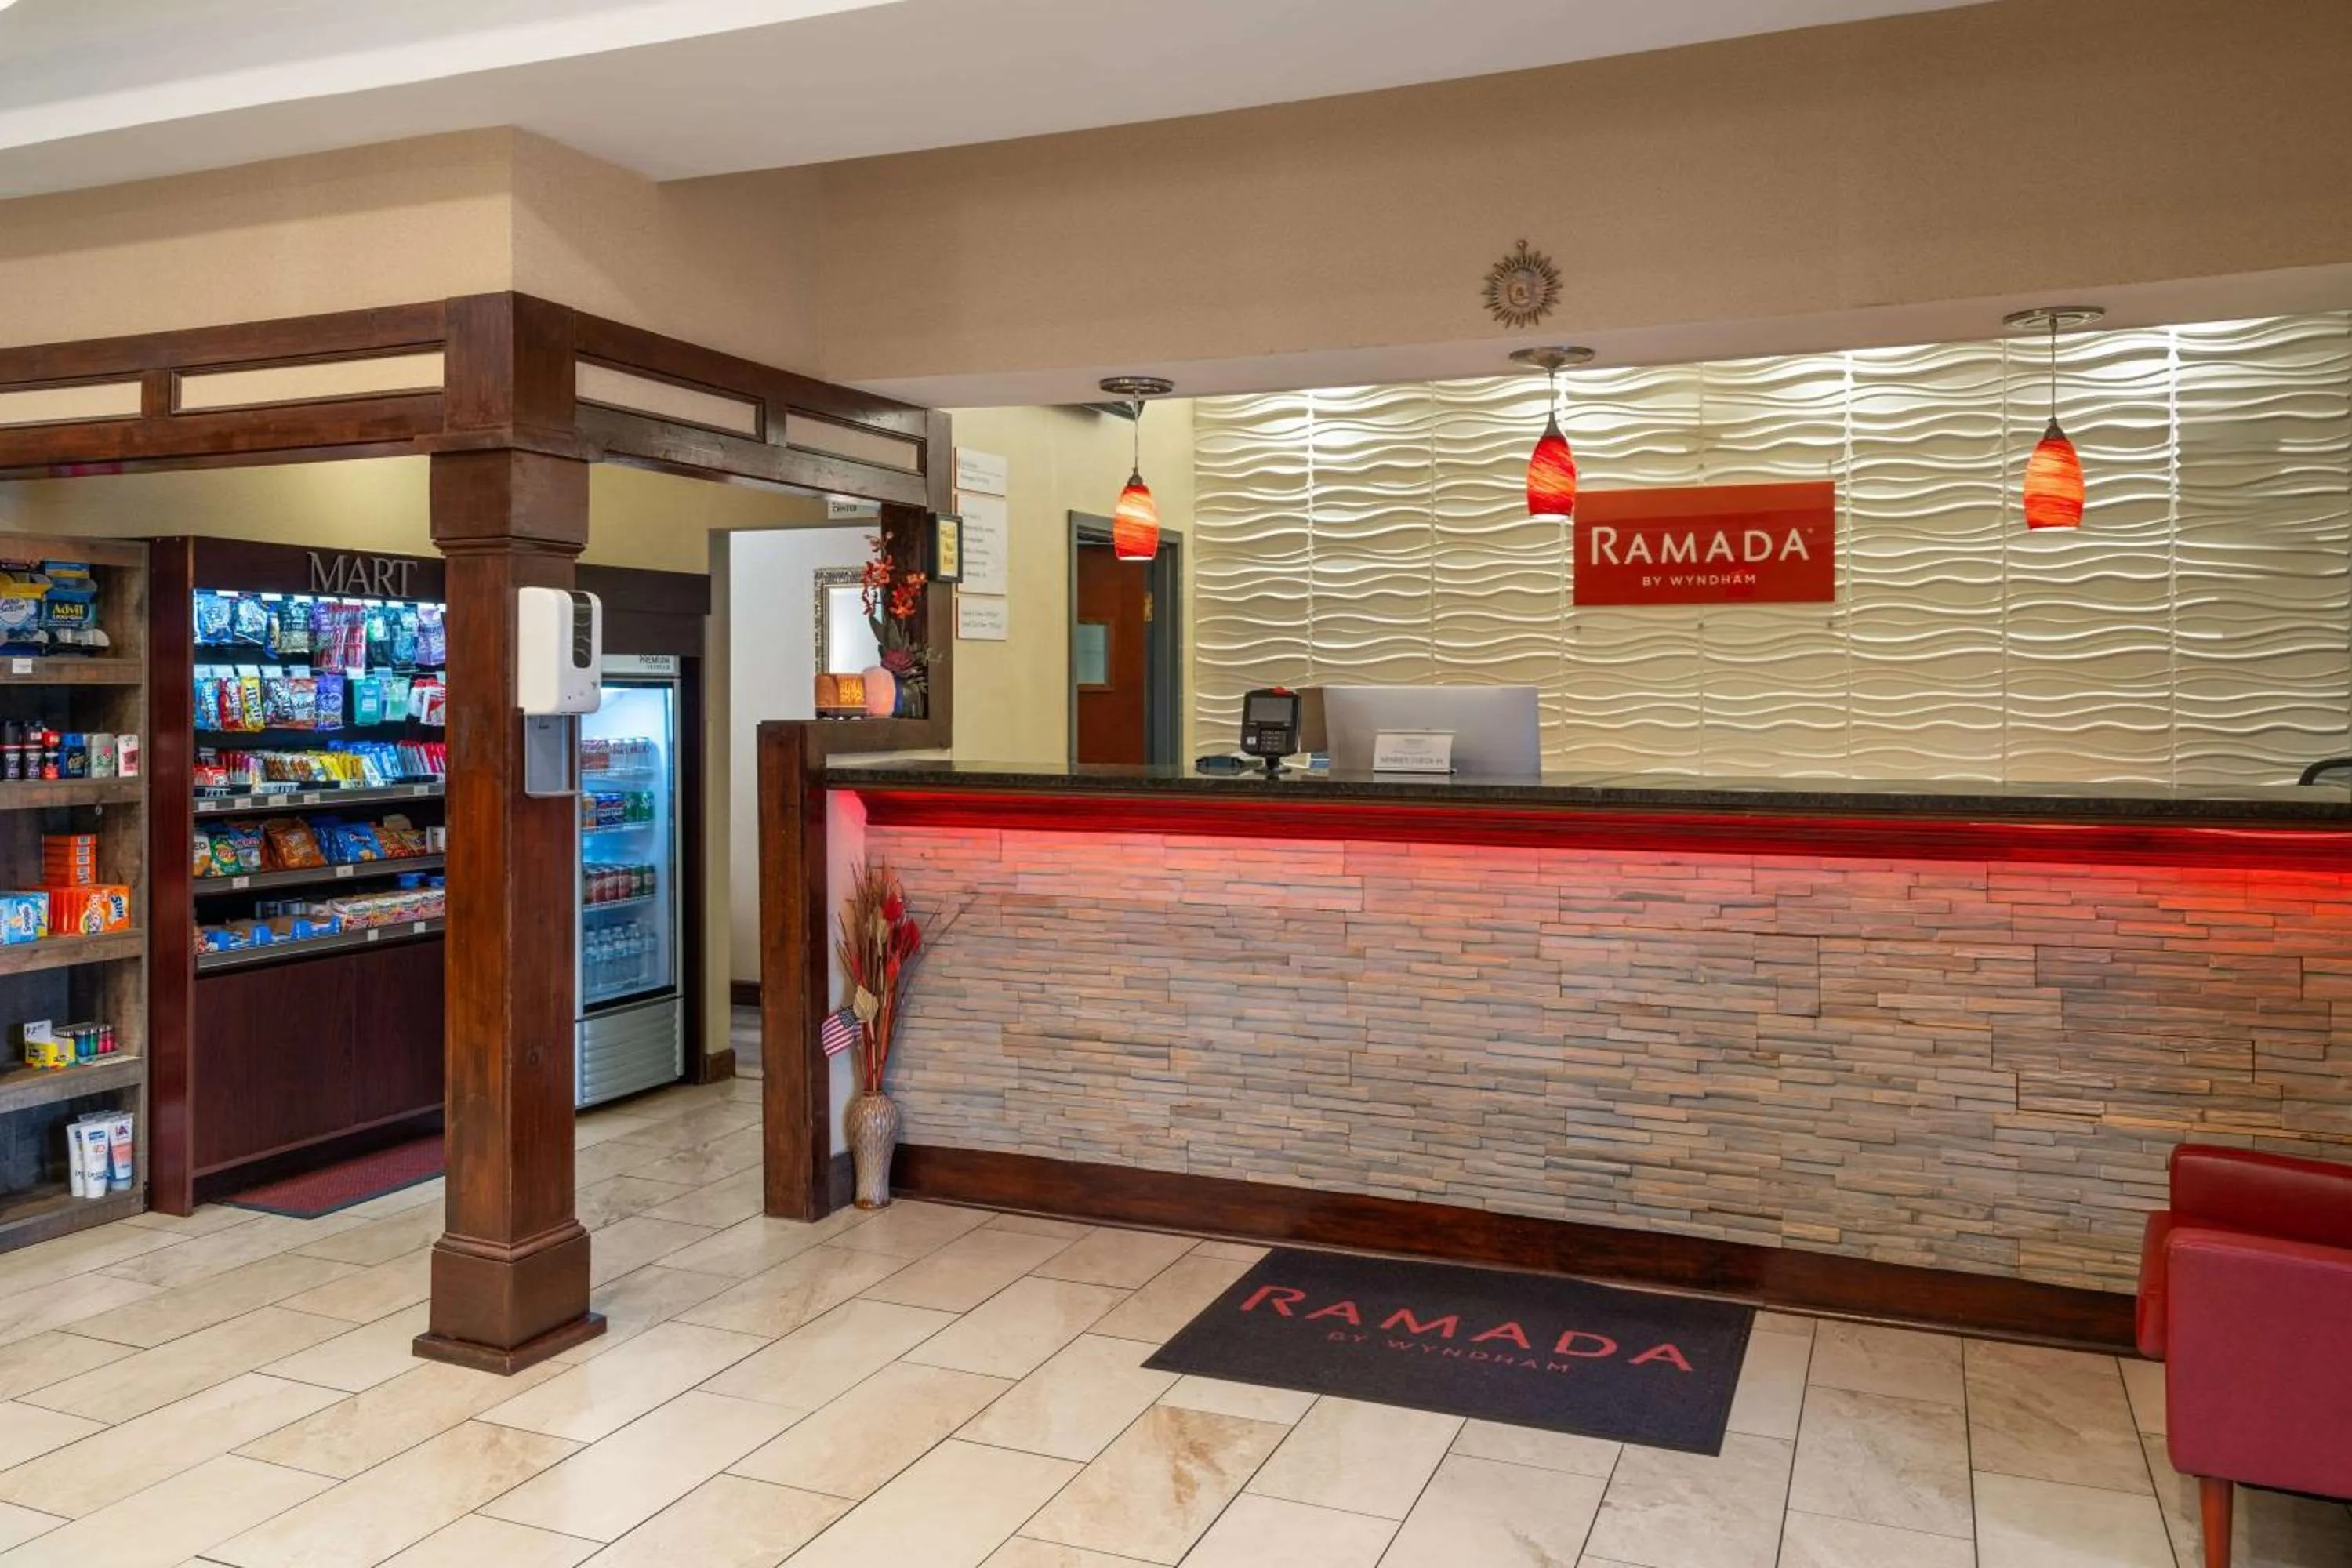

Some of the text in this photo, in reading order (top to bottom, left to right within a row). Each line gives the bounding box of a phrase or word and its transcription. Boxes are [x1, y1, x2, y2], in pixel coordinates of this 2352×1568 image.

[1591, 526, 1810, 565] RAMADA
[307, 551, 418, 598] MART
[1642, 574, 1756, 586] BY WYNDHAM
[53, 603, 84, 615] Advil
[1239, 1285, 1695, 1372] RAMADA
[1328, 1331, 1570, 1372] BY WYNDHAM
